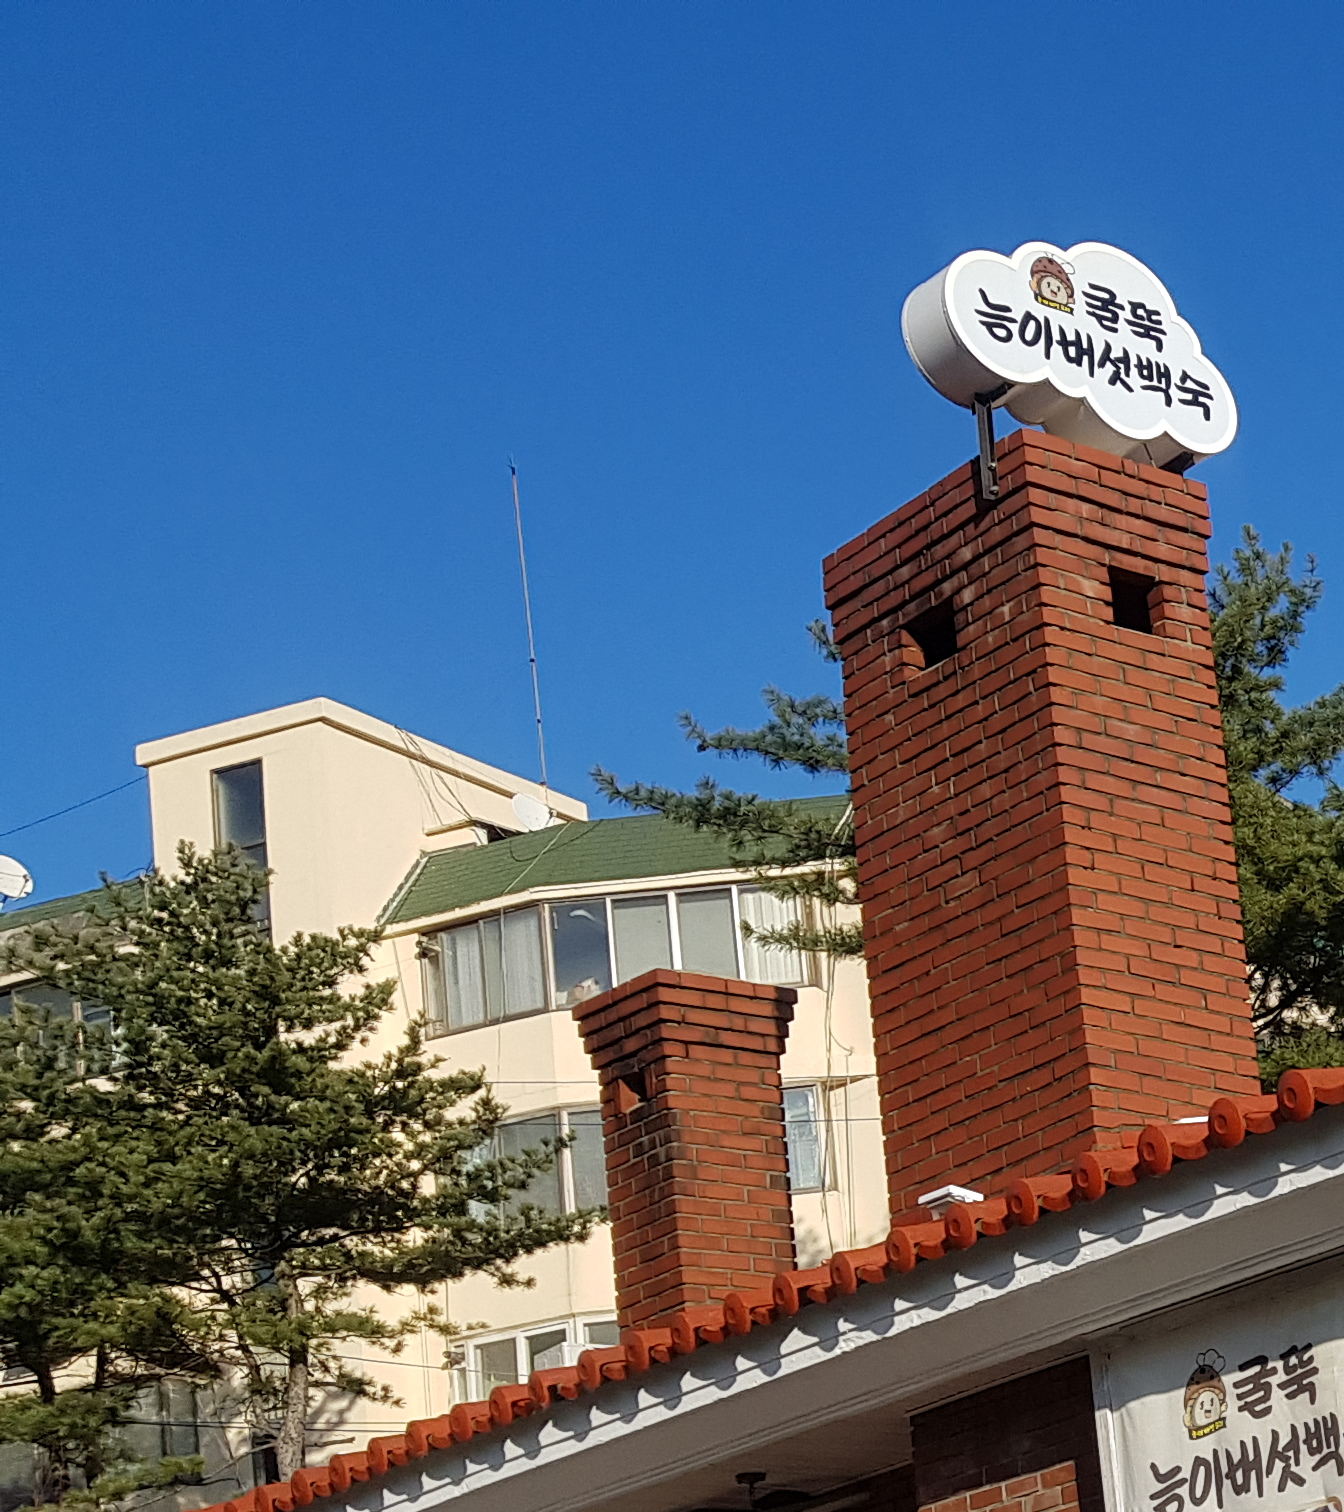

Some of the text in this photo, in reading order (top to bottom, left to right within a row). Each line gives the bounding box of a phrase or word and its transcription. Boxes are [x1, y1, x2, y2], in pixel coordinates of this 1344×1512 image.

[973, 288, 1215, 422] 능이버섯백숙
[1081, 282, 1168, 353] 굴뚝
[1232, 1342, 1320, 1420] 굴뚝
